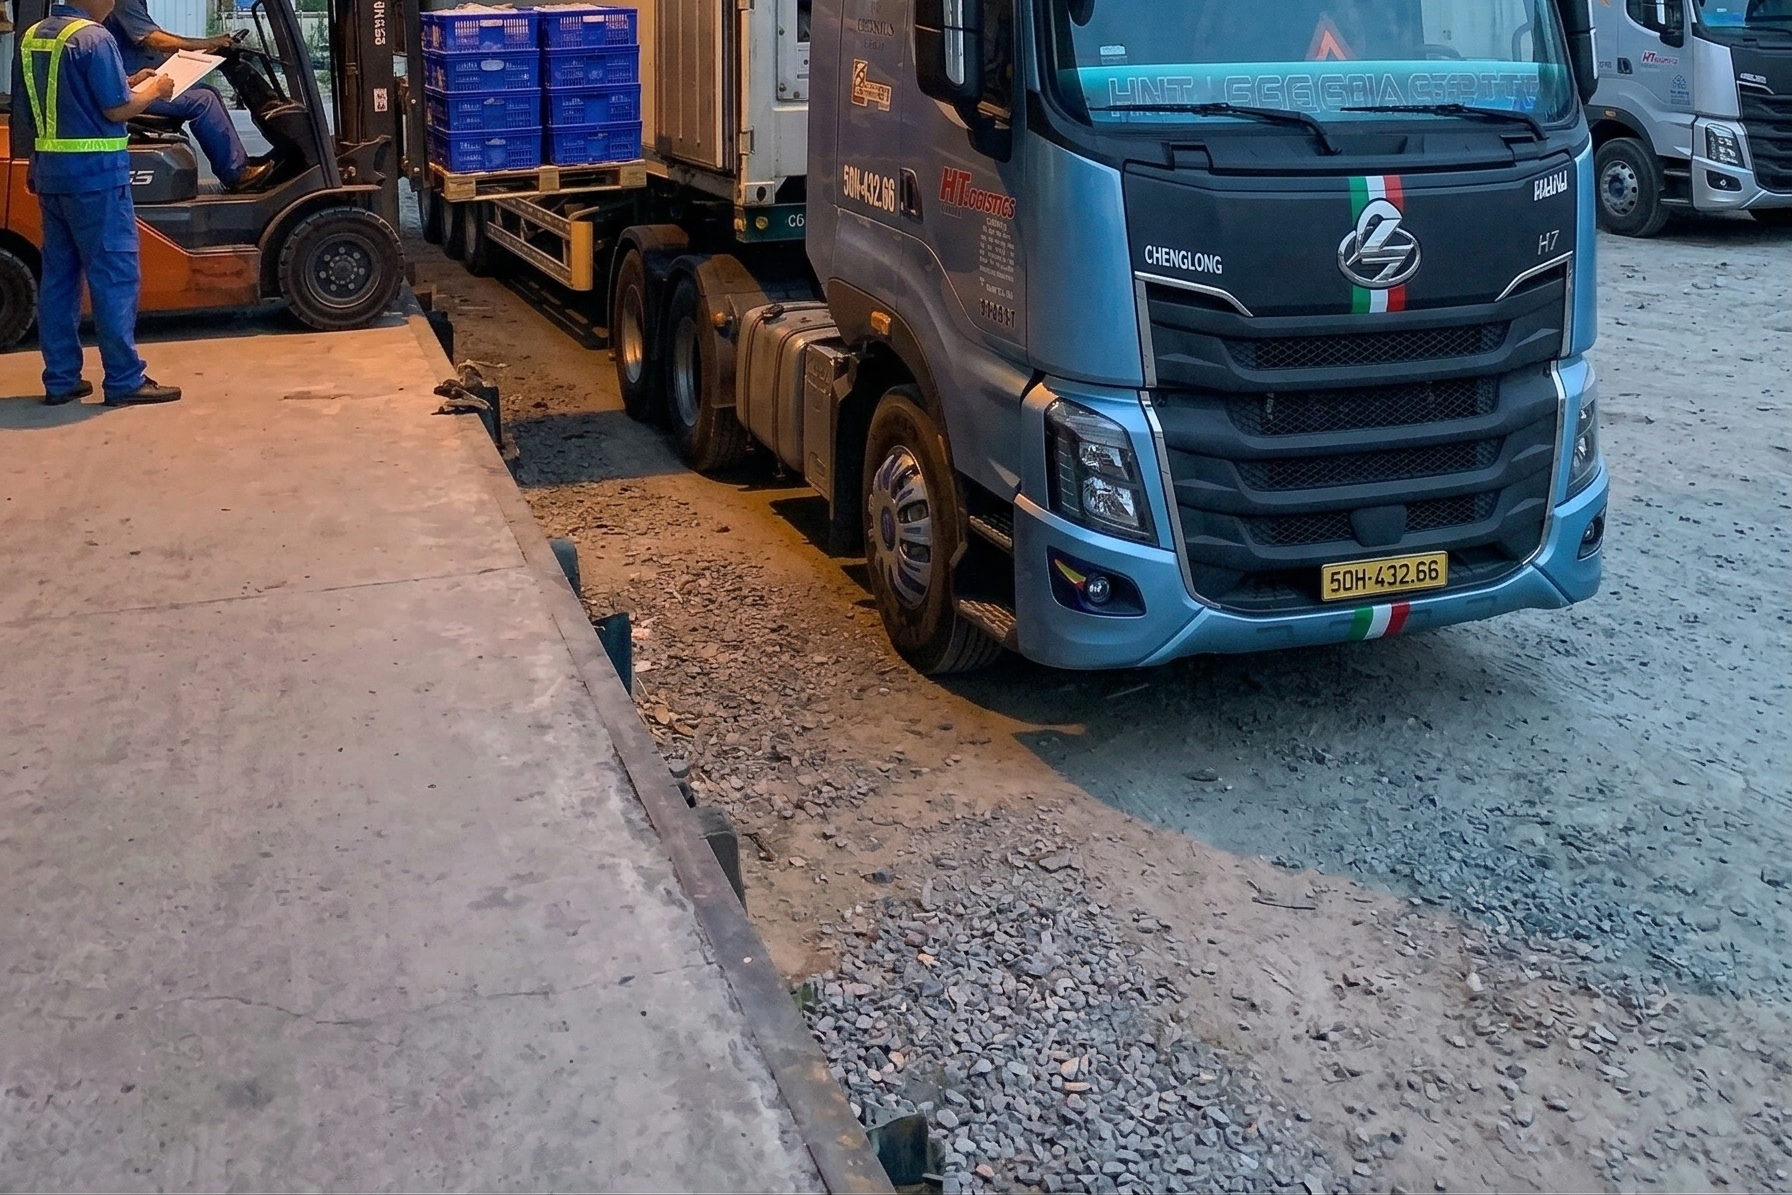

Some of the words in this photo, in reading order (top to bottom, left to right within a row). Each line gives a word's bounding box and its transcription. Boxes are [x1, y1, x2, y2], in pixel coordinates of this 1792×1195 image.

[1537, 229, 1560, 255] H7
[1144, 244, 1223, 275] CHENGLONG
[1329, 559, 1440, 593] 50H-432.66
